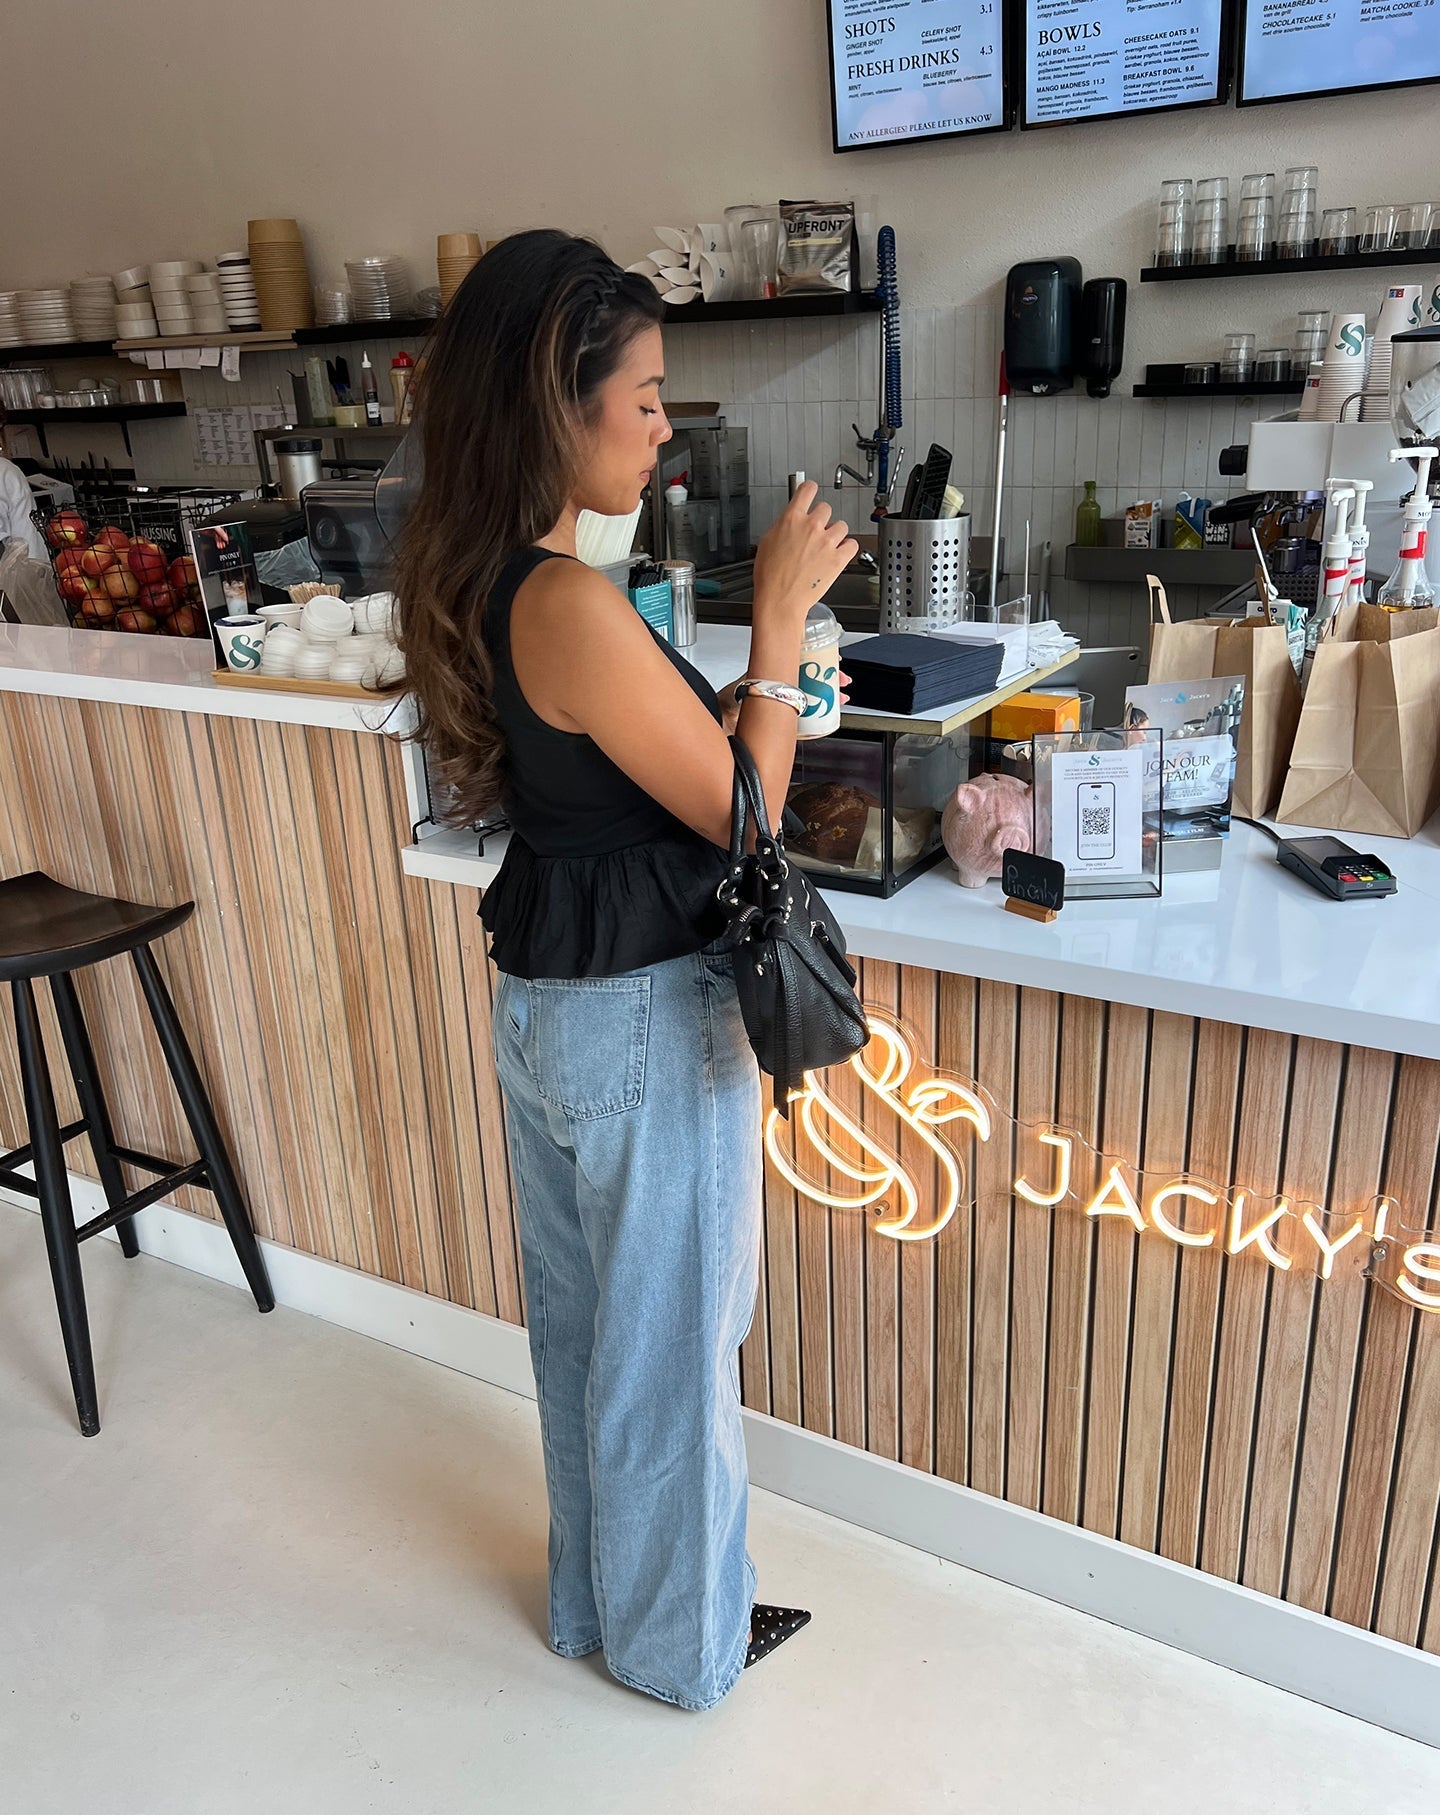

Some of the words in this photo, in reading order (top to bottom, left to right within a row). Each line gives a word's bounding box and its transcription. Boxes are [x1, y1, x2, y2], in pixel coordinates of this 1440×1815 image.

[980, 3, 992, 14] 3.1
[1263, 0, 1316, 12] BANANABREAD
[1360, 5, 1390, 15] MATCHA
[845, 17, 896, 39] SHOTS
[1262, 14, 1324, 29] CHOCOLATECAKE
[921, 28, 944, 38] CELERY
[945, 25, 962, 34] SHOT
[1038, 21, 1101, 46] BOWLS
[1124, 32, 1168, 44] CHEESECAKE
[1169, 29, 1188, 38] OATS
[846, 41, 867, 50] GINGER
[868, 38, 883, 46] SHOT
[980, 45, 993, 56] 4.3
[1053, 48, 1070, 56] BOWL
[848, 59, 894, 80] FRESH
[900, 48, 960, 71] DRINKS
[922, 69, 957, 80] BLUEBERRY
[1123, 70, 1161, 80] BREAKFAST
[1036, 84, 1059, 93] MANGO
[1060, 80, 1090, 90] MADNESS
[848, 132, 865, 140] ANY
[910, 122, 936, 132] PLEASE
[938, 120, 951, 128] LET
[954, 118, 964, 126] US
[966, 114, 992, 124] KNOW
[788, 219, 844, 234] UPFRONT
[219, 554, 228, 562] PIN
[228, 552, 240, 560] ONLY
[1144, 758, 1176, 776] JOIN
[1180, 755, 1210, 768] OUR
[1007, 864, 1024, 898] Pin
